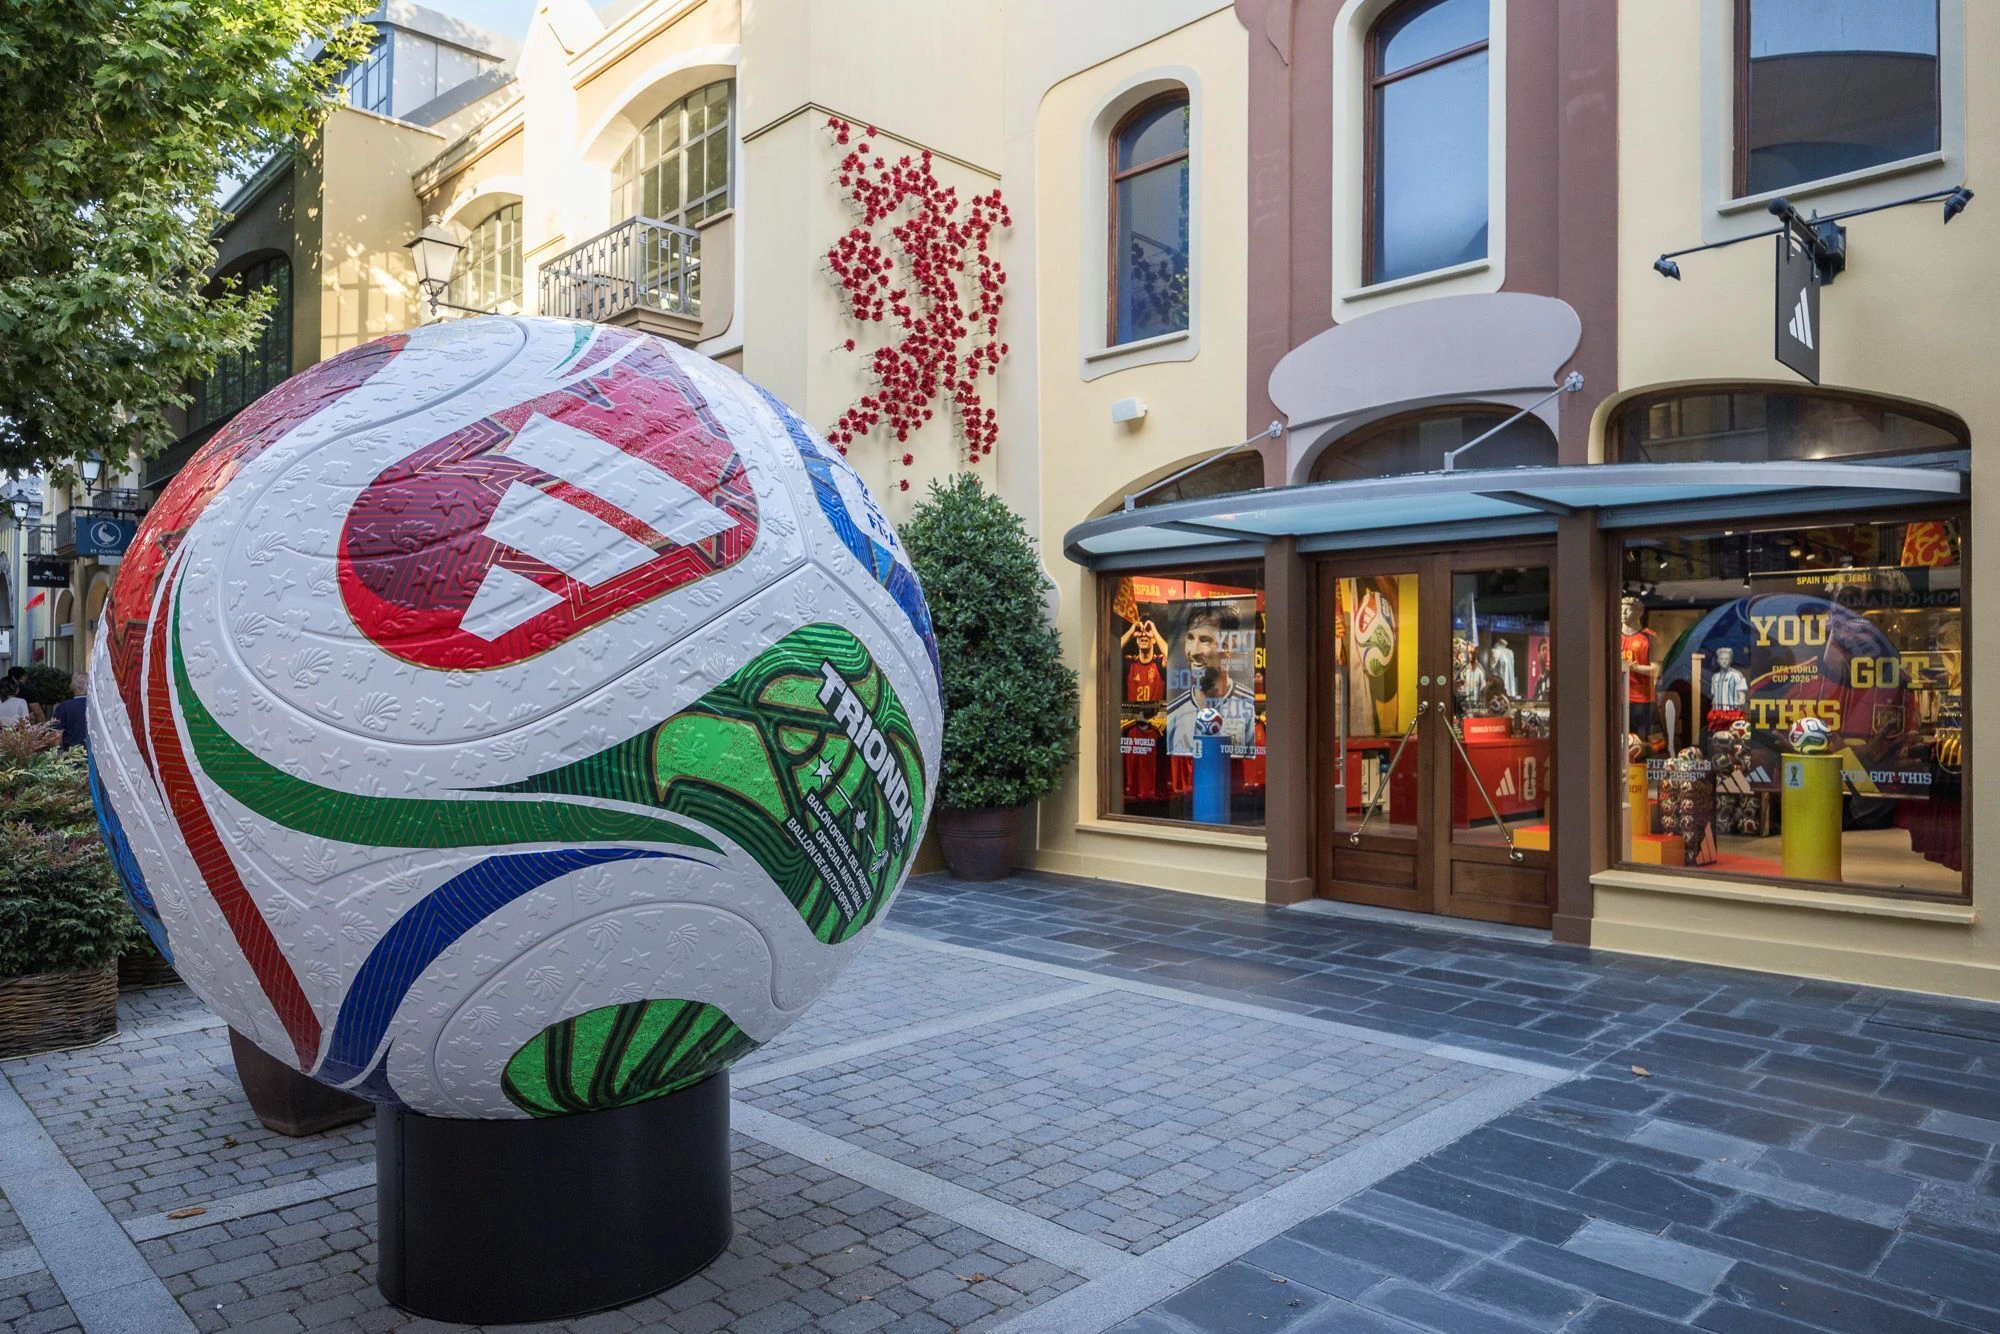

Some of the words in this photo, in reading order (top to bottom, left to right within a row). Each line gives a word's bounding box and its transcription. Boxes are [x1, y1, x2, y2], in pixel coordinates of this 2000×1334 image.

[1796, 576, 1820, 585] SPAIN
[1822, 574, 1846, 584] HOME
[1750, 614, 1830, 647] YOU
[1215, 630, 1255, 653] YOU
[1772, 665, 1791, 673] FIFA
[1792, 664, 1818, 674] WORLD
[1850, 656, 1930, 689] GOT
[1772, 675, 1788, 683] CUP
[1136, 685, 1151, 702] 20
[1750, 698, 1841, 732] THIS
[1120, 737, 1133, 746] FIFA
[1134, 737, 1156, 747] WORLD
[1120, 746, 1132, 754] CUP
[1220, 744, 1234, 754] YOU
[1234, 745, 1248, 754] GOT
[1249, 745, 1266, 755] THIS
[818, 660, 913, 843] TRIONDA
[1646, 770, 1667, 780] CUP
[1840, 770, 1867, 782] YOU
[1869, 770, 1896, 783] GOT
[1898, 771, 1933, 785] THIS
[806, 793, 833, 828] BALÓN
[828, 823, 850, 859] OFICIAL
[847, 853, 859, 873] DEL
[855, 868, 872, 901] PARTIDO
[786, 817, 818, 857] BALLON
[813, 854, 825, 869] DE
[820, 863, 842, 896] MATCH
[838, 890, 855, 922] OFFICIEL
[815, 829, 844, 871] OFFICIAL
[839, 865, 857, 896] MATCH
[851, 889, 863, 911] BALL
